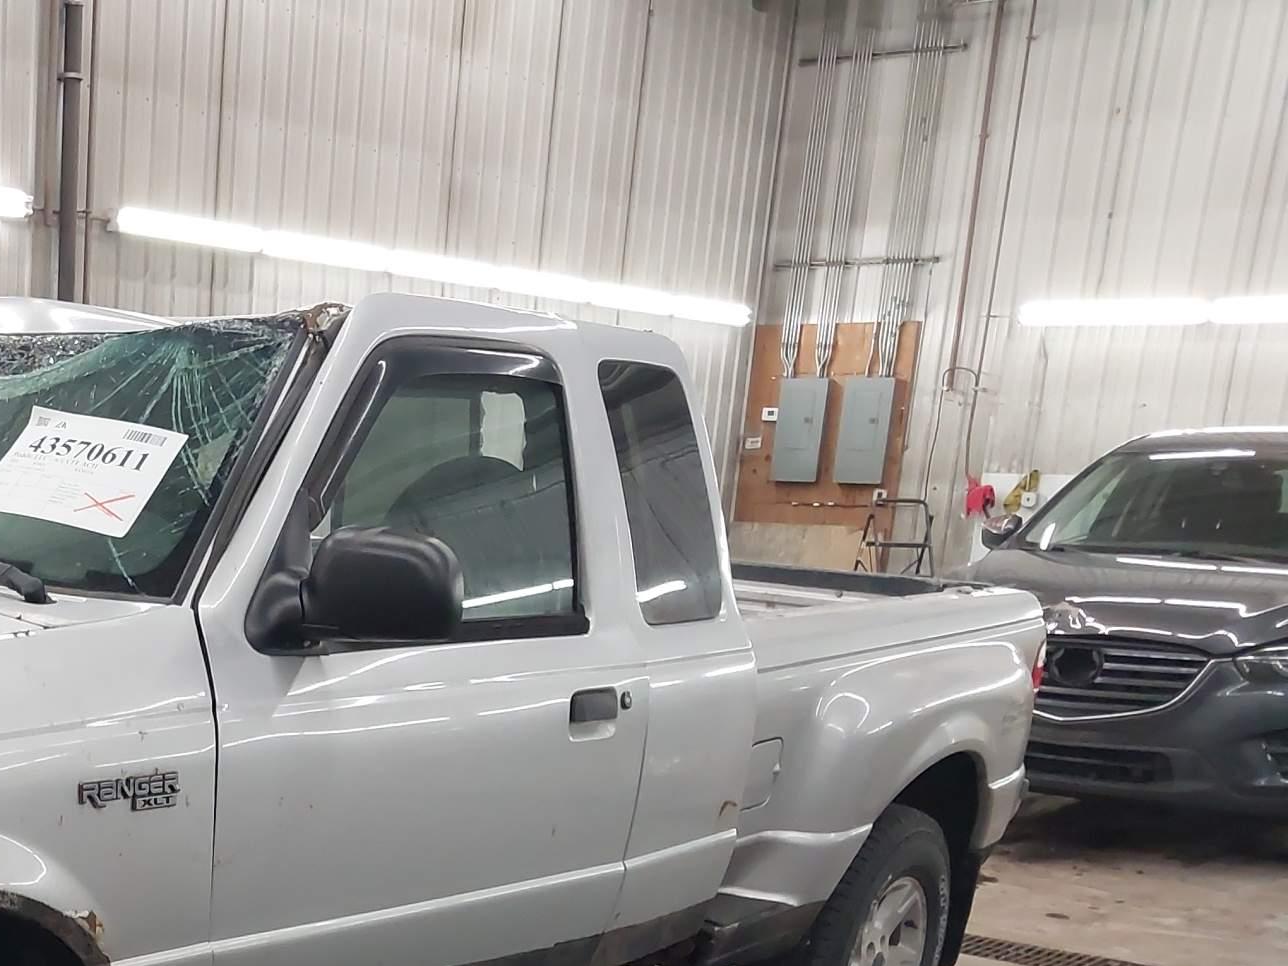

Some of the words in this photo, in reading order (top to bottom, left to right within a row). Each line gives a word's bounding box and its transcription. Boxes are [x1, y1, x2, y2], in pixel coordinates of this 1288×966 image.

[29, 435, 150, 471] 43570611
[78, 770, 180, 809] RANGER
[138, 795, 173, 808] XLT
